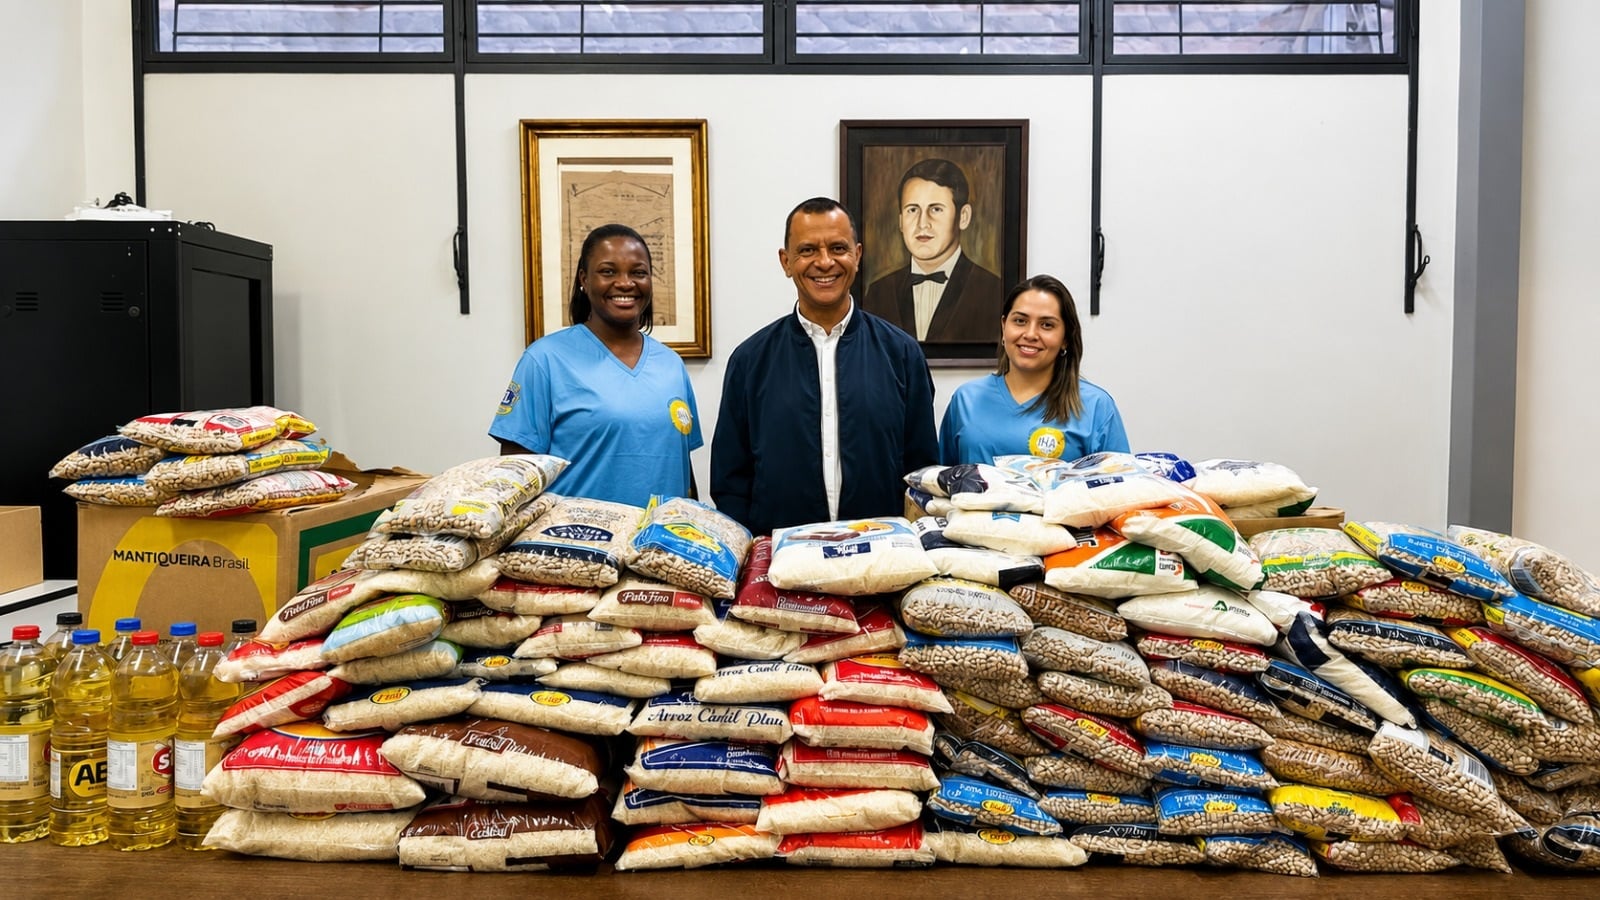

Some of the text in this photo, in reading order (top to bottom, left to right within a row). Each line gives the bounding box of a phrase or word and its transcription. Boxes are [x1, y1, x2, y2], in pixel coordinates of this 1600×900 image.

[113, 549, 250, 570] MANTIQUEIRA Brasil
[645, 590, 669, 605] Fino
[647, 708, 692, 722] Arroz
